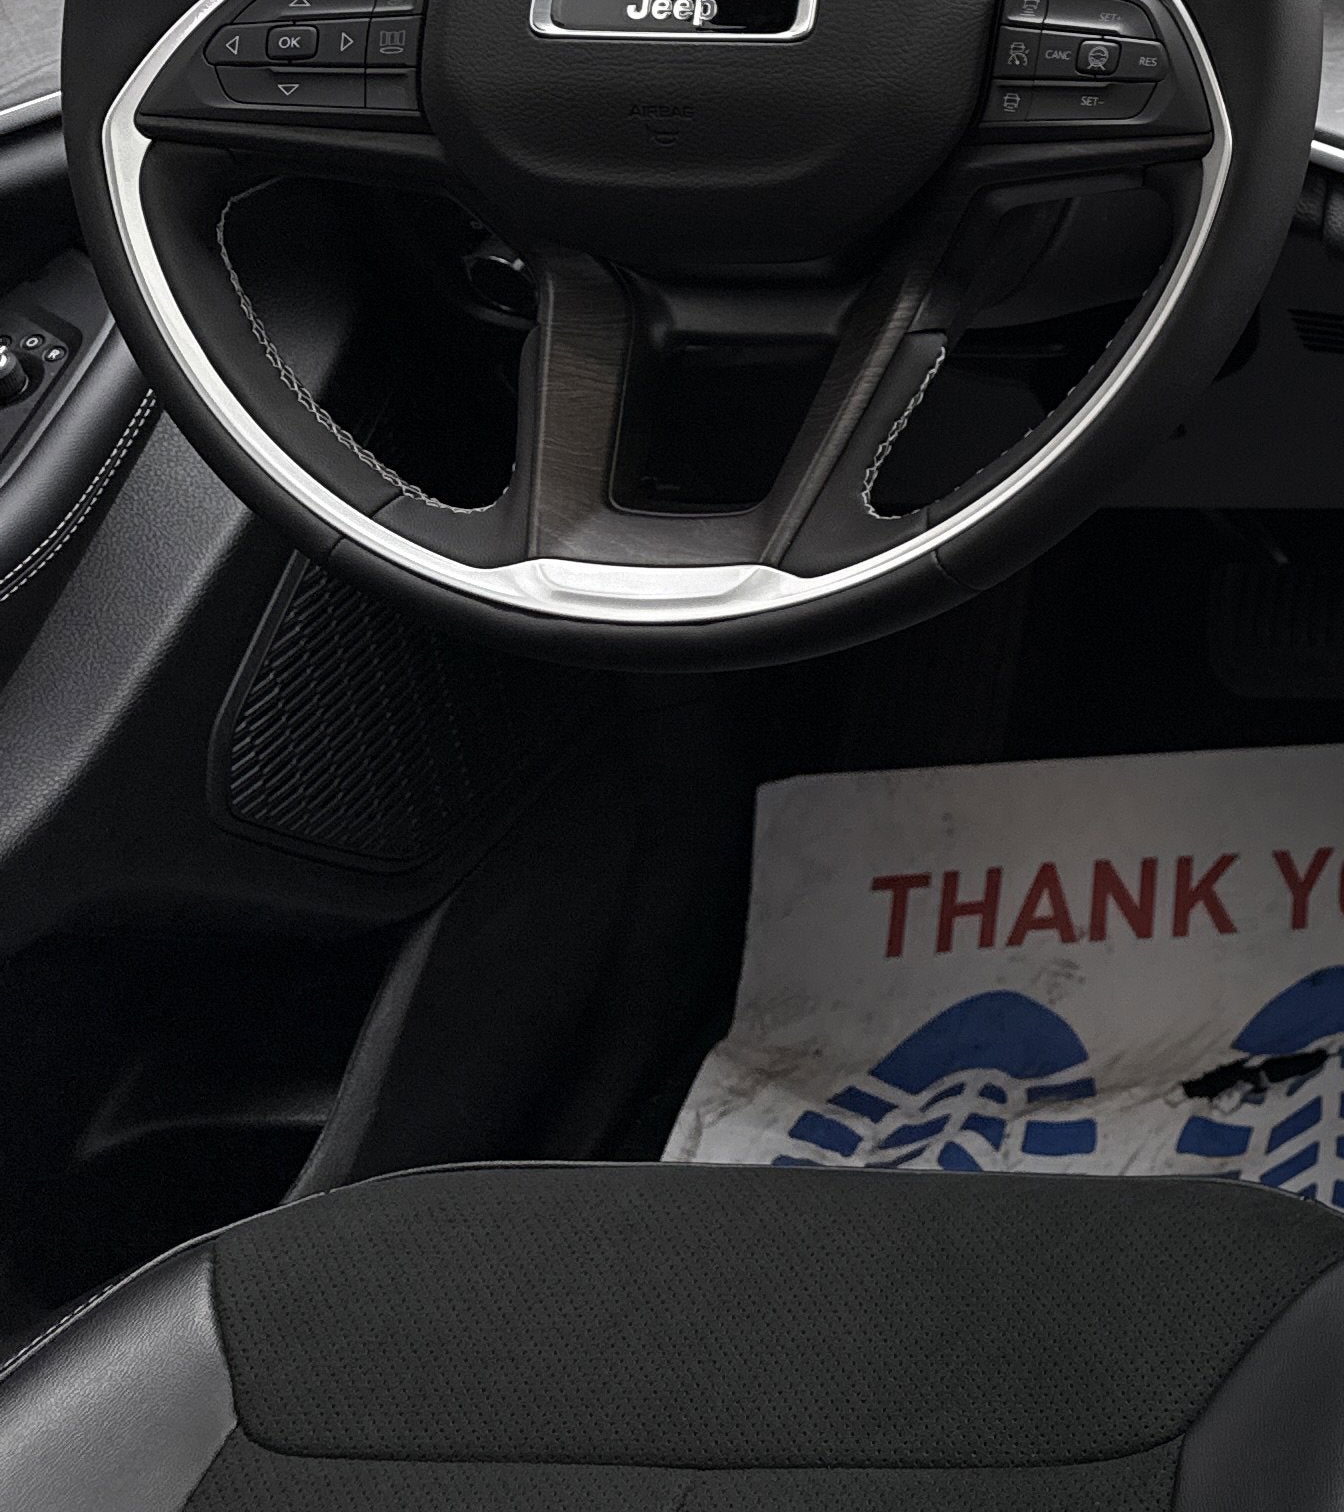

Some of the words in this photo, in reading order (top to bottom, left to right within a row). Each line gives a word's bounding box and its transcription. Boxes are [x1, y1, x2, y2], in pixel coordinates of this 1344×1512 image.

[279, 37, 300, 48] OK
[1046, 50, 1071, 60] CANC
[1139, 57, 1157, 66] RES
[870, 852, 1238, 958] THANK
